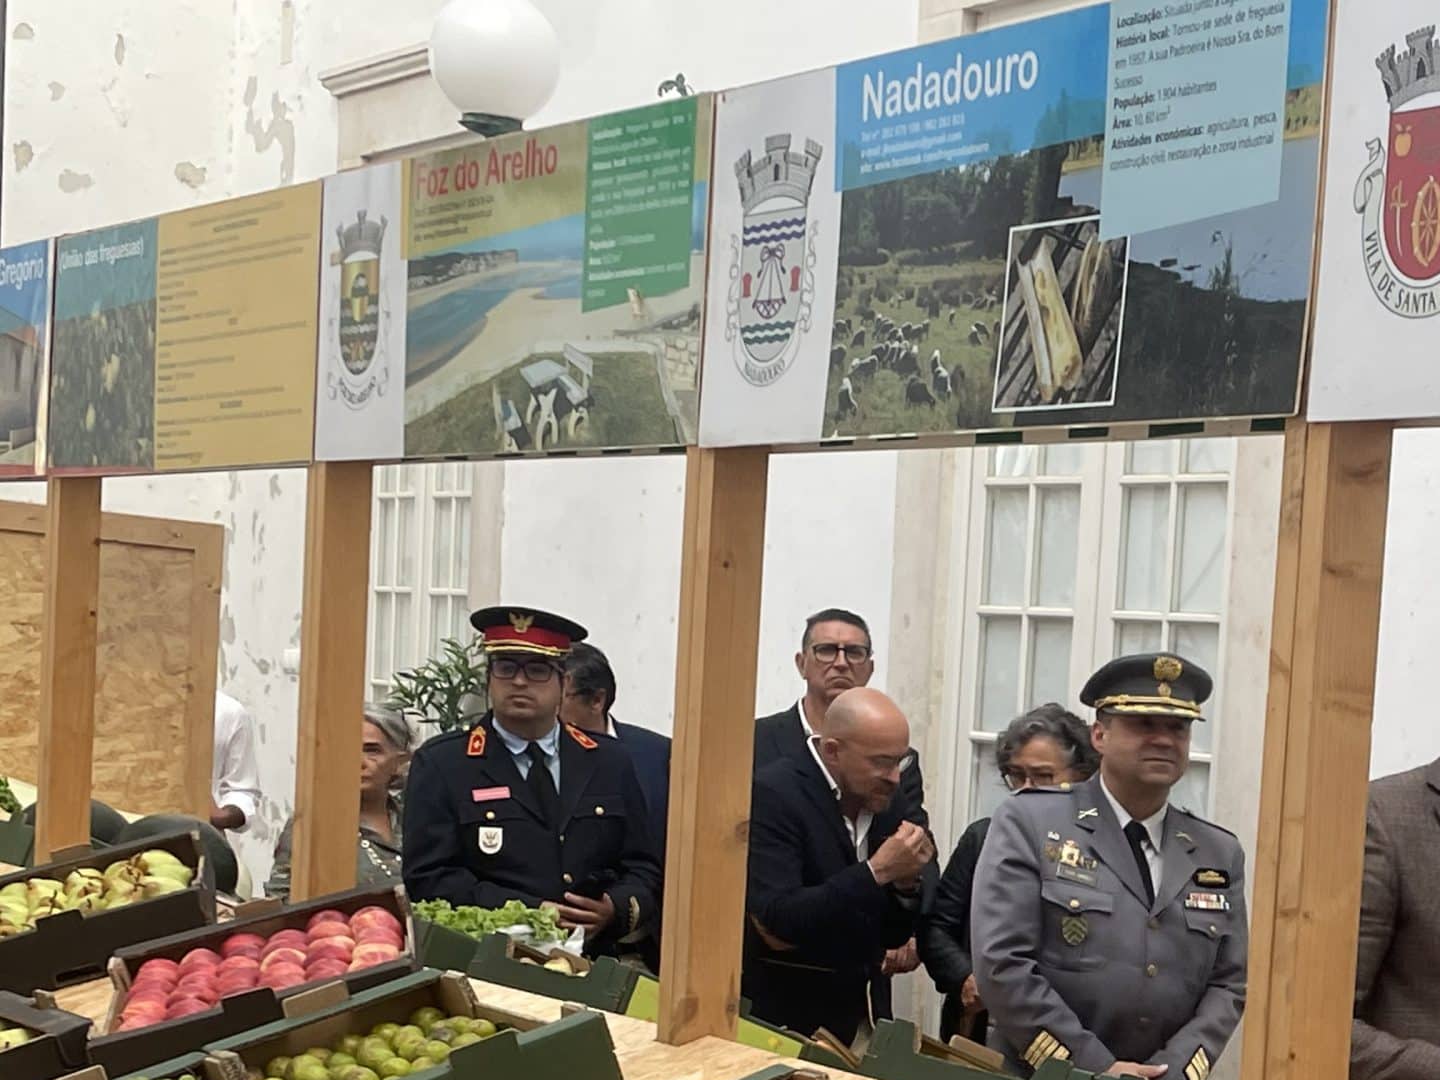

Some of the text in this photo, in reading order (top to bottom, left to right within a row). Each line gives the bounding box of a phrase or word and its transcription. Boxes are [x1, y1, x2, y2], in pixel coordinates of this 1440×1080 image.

[1115, 30, 1147, 49] História
[1173, 20, 1212, 36] Tornou-se
[1214, 13, 1233, 27] sede
[1235, 10, 1246, 23] de
[1248, 3, 1285, 22] freguesia
[1116, 8, 1163, 29] Localização:
[1115, 58, 1127, 70] em
[1213, 35, 1236, 49] Nossa
[1253, 28, 1264, 41] do
[1265, 24, 1284, 38] Bom
[862, 50, 1039, 123] Nadadouro
[1113, 91, 1156, 110] População:
[1112, 133, 1152, 150] Atividades
[416, 162, 450, 201] Foz
[454, 154, 479, 192] do
[485, 138, 558, 187] Arelho
[1365, 230, 1382, 277] VILA
[1377, 272, 1396, 301] DE
[1394, 289, 1437, 314] SANTA
